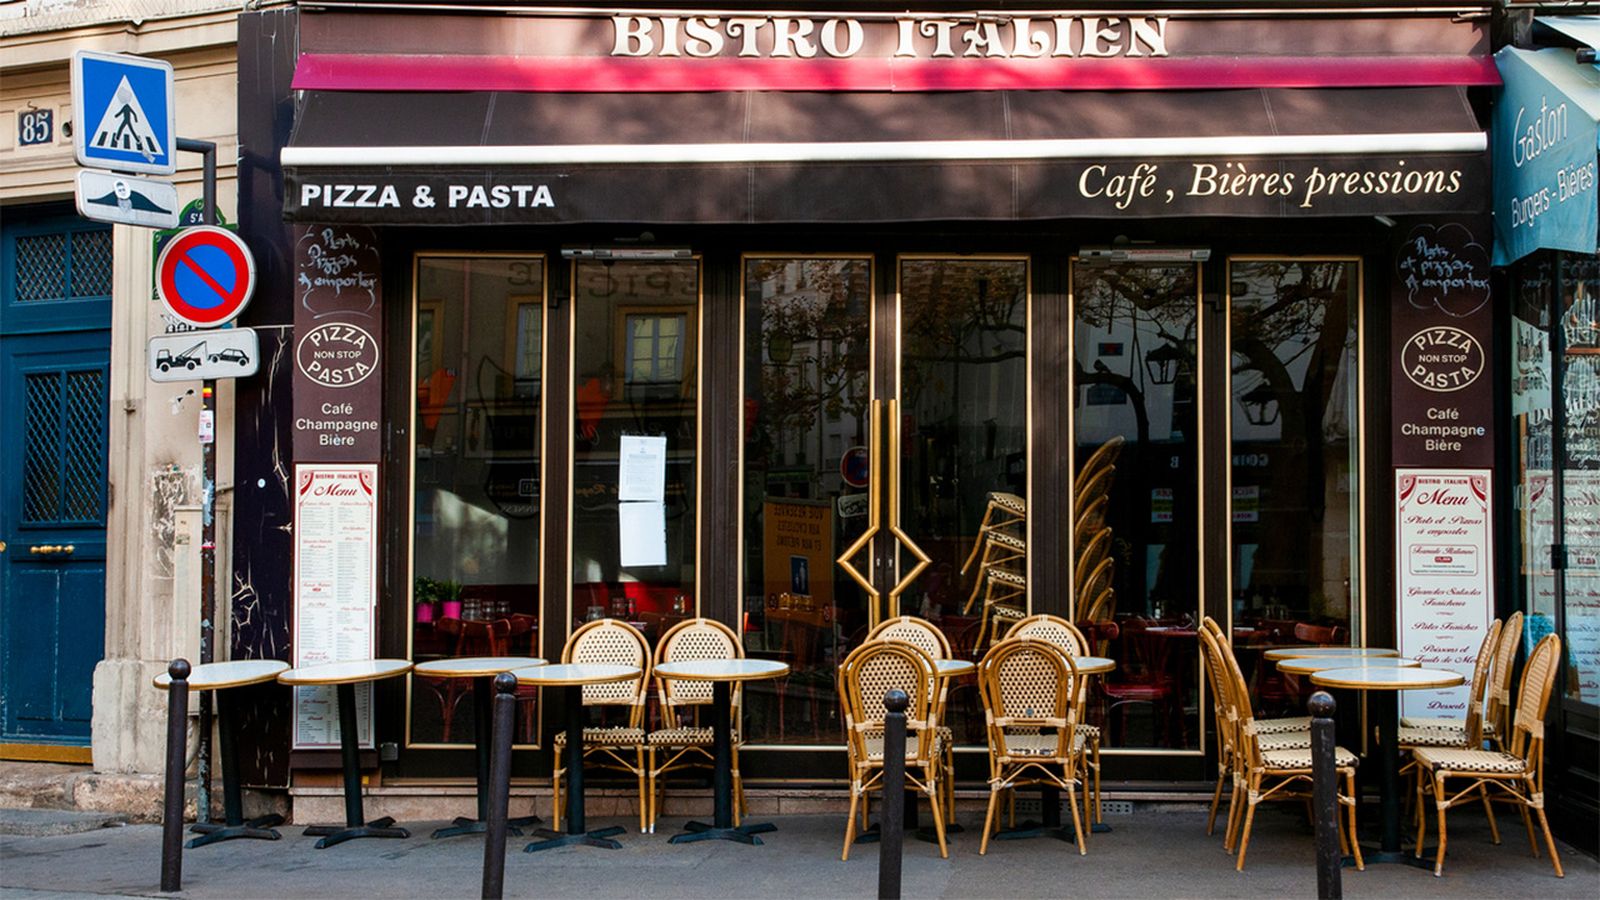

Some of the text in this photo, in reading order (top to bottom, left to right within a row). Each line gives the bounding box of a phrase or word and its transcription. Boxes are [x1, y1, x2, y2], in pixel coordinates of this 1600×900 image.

[610, 16, 1171, 57] BISTRO ITALIEN
[22, 111, 49, 142] 85
[1512, 95, 1568, 168] Gaston
[1078, 163, 1158, 210] Café
[1186, 162, 1295, 197] Bières
[1300, 160, 1462, 208] pressions
[301, 184, 555, 208] PIZZA & PASTA
[1511, 186, 1550, 228] Burgers
[1557, 161, 1594, 204] Bières
[1422, 272, 1489, 296] emporter
[310, 326, 367, 350] PIZZA
[1414, 329, 1471, 354] PIZZA
[314, 351, 362, 359] NON STOP
[1418, 354, 1468, 363] NON STOP
[307, 360, 370, 383] PASTA
[1411, 364, 1476, 388] PASTA
[321, 402, 353, 415] Café
[1426, 407, 1459, 420] Café
[295, 418, 378, 432] Champagne
[1401, 423, 1486, 437] Champagne
[319, 434, 355, 446] Bière
[1425, 438, 1462, 452] Bière
[314, 482, 357, 497] Menu
[1416, 488, 1469, 506] Menu
[1404, 515, 1433, 525] Plats
[1446, 586, 1482, 596] Salades
[1420, 644, 1458, 653] Poissons
[1427, 700, 1466, 710] Desserts
